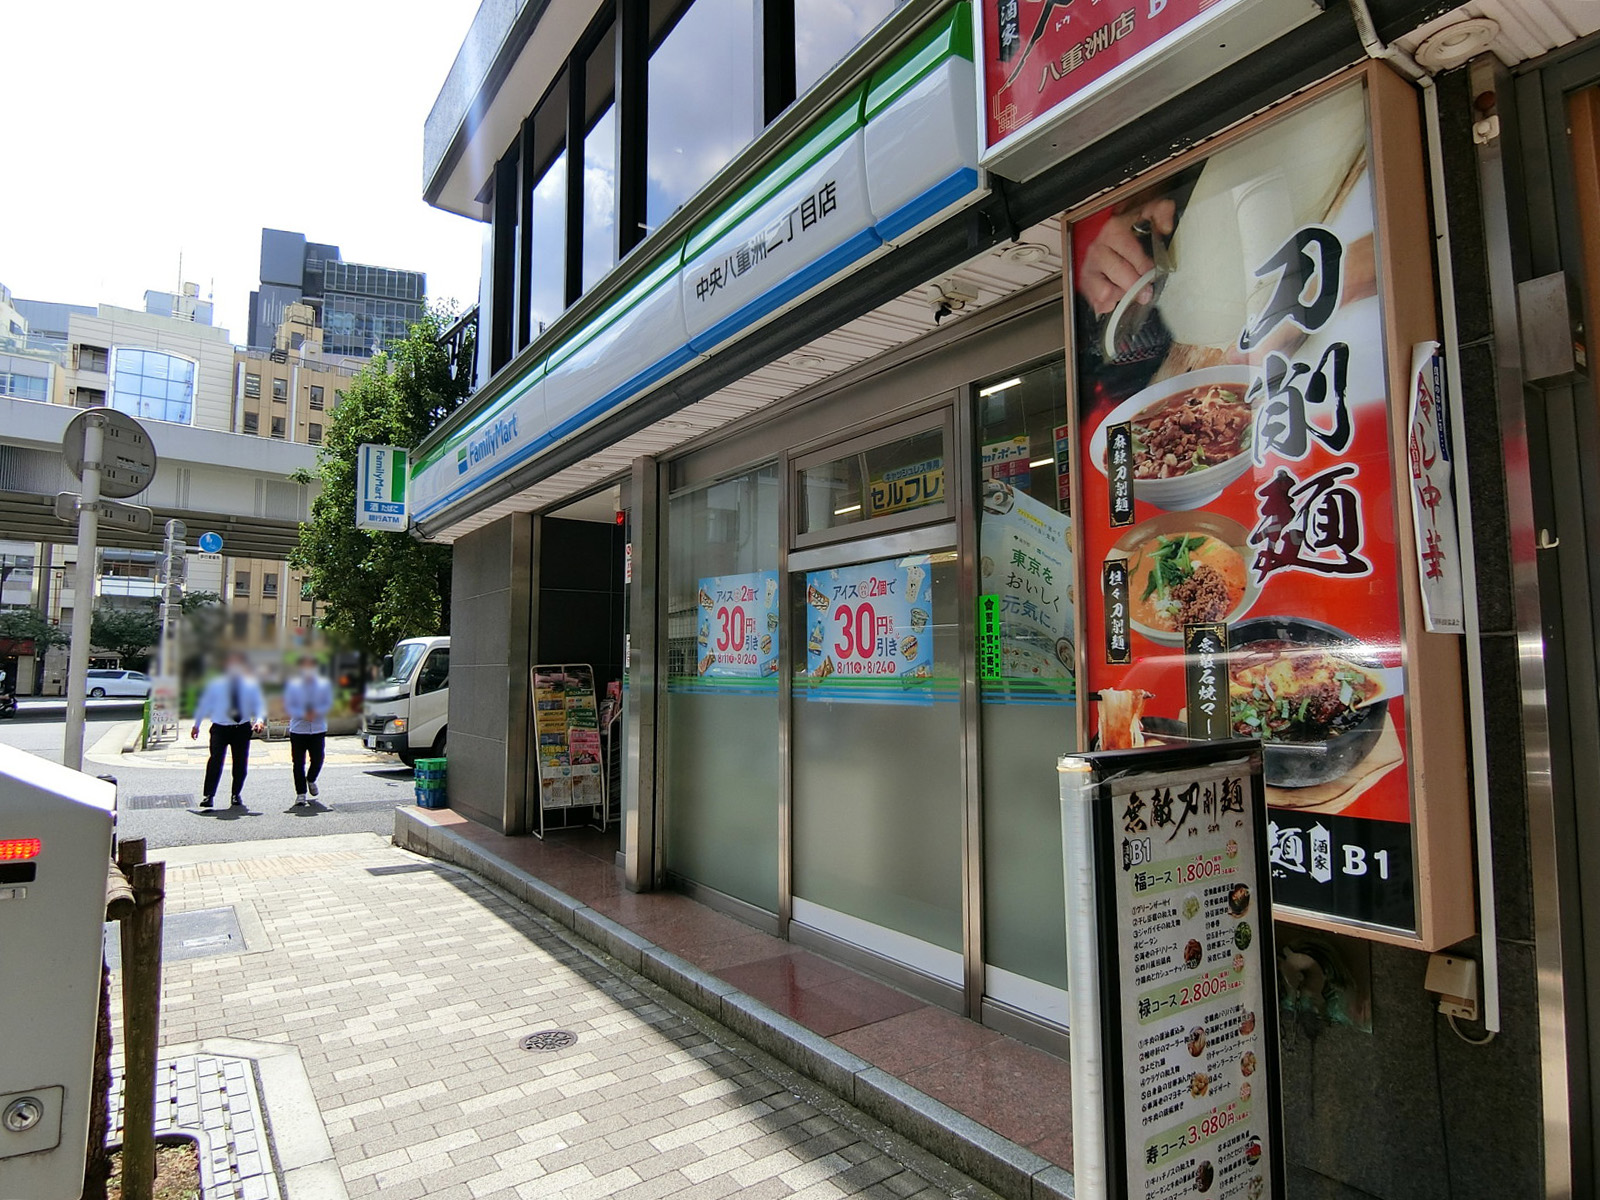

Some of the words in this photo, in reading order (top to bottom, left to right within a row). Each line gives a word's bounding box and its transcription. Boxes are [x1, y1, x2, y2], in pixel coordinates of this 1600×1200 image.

[1038, 8, 1136, 92] 八重洲店
[696, 181, 837, 302] 中央八重洲二丁目店
[1240, 226, 1373, 585] 刀削麺
[469, 413, 518, 466] FamilyMart
[373, 450, 386, 499] FamilyMart
[1112, 433, 1130, 513] 麻辣刀削麺
[368, 516, 400, 524] 銀行ATM
[381, 504, 399, 512] たばこ
[1010, 549, 1053, 586] 東京を
[716, 590, 734, 603] アイス
[833, 585, 859, 601] アイス
[869, 576, 897, 598] 2個で
[1006, 572, 1060, 613] おいしく
[1108, 570, 1126, 651] 担々刀削麺
[1198, 637, 1217, 742] 無敵石焼マー
[1122, 776, 1245, 844] 無敵刀削麺
[1129, 837, 1152, 866] B1
[1313, 838, 1329, 872] 酒家
[1342, 844, 1389, 880] B1
[1134, 865, 1172, 892] 福コース
[1138, 988, 1177, 1019] 禄コース
[1146, 1131, 1186, 1166] 寿コース
